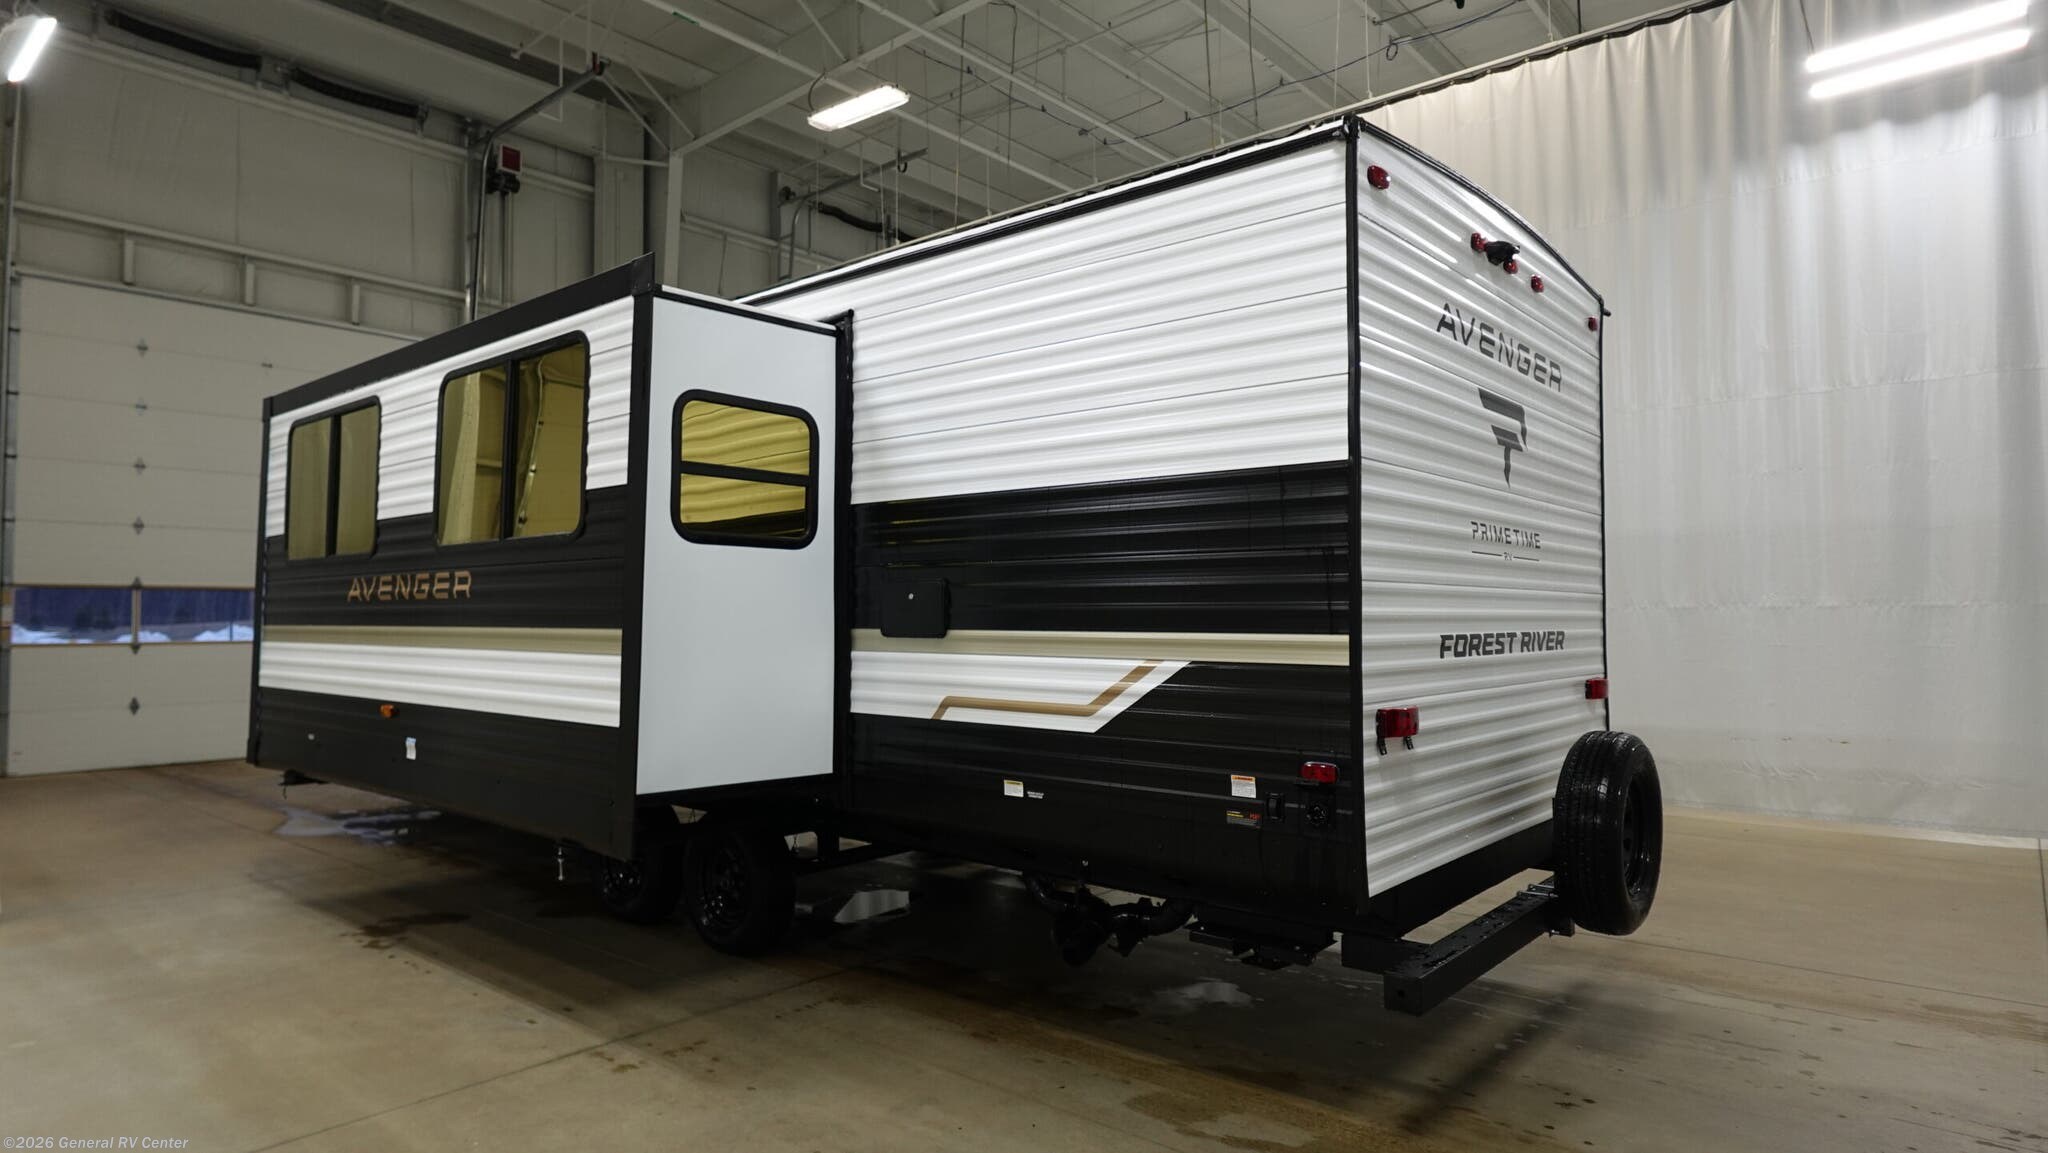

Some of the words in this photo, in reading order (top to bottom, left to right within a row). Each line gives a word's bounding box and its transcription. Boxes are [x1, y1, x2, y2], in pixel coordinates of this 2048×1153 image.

[1437, 303, 1562, 392] AVENGER
[346, 570, 472, 602] AVENGER
[1440, 632, 1517, 659] FOREST
[1520, 630, 1566, 653] RIVER
